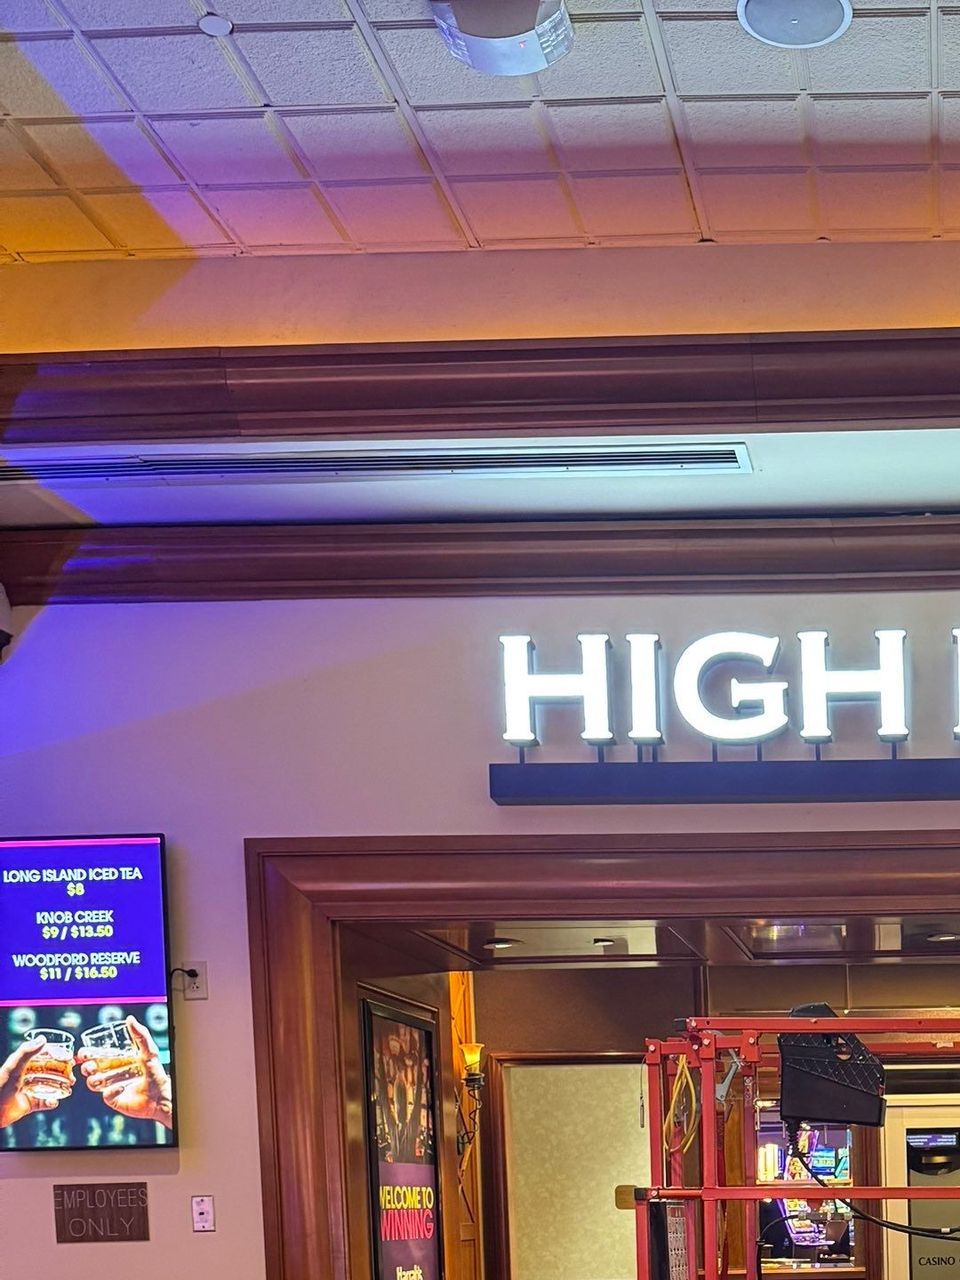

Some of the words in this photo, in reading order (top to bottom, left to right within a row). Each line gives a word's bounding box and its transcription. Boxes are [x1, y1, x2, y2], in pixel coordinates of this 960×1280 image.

[498, 630, 909, 744] HIGH
[3, 870, 41, 883] LONG
[42, 868, 87, 882] ISLAND
[88, 867, 119, 881] ICED
[119, 866, 143, 880] TEA
[66, 882, 85, 897] $8
[36, 911, 73, 924] KNOB
[74, 910, 114, 923] CREEK
[42, 926, 59, 939] $9
[60, 926, 68, 940] /
[70, 925, 113, 939] $13.50
[12, 953, 89, 967] WOODFORD
[90, 951, 141, 965] RESERVE
[39, 967, 61, 981] $11
[64, 967, 72, 981] /
[75, 966, 118, 980] $16.50
[55, 1188, 147, 1209] EMPLOYEES
[421, 1186, 434, 1209] TO
[69, 1217, 135, 1238] ONLY
[381, 1209, 434, 1241] WINNING
[918, 1256, 956, 1266] CASINO
